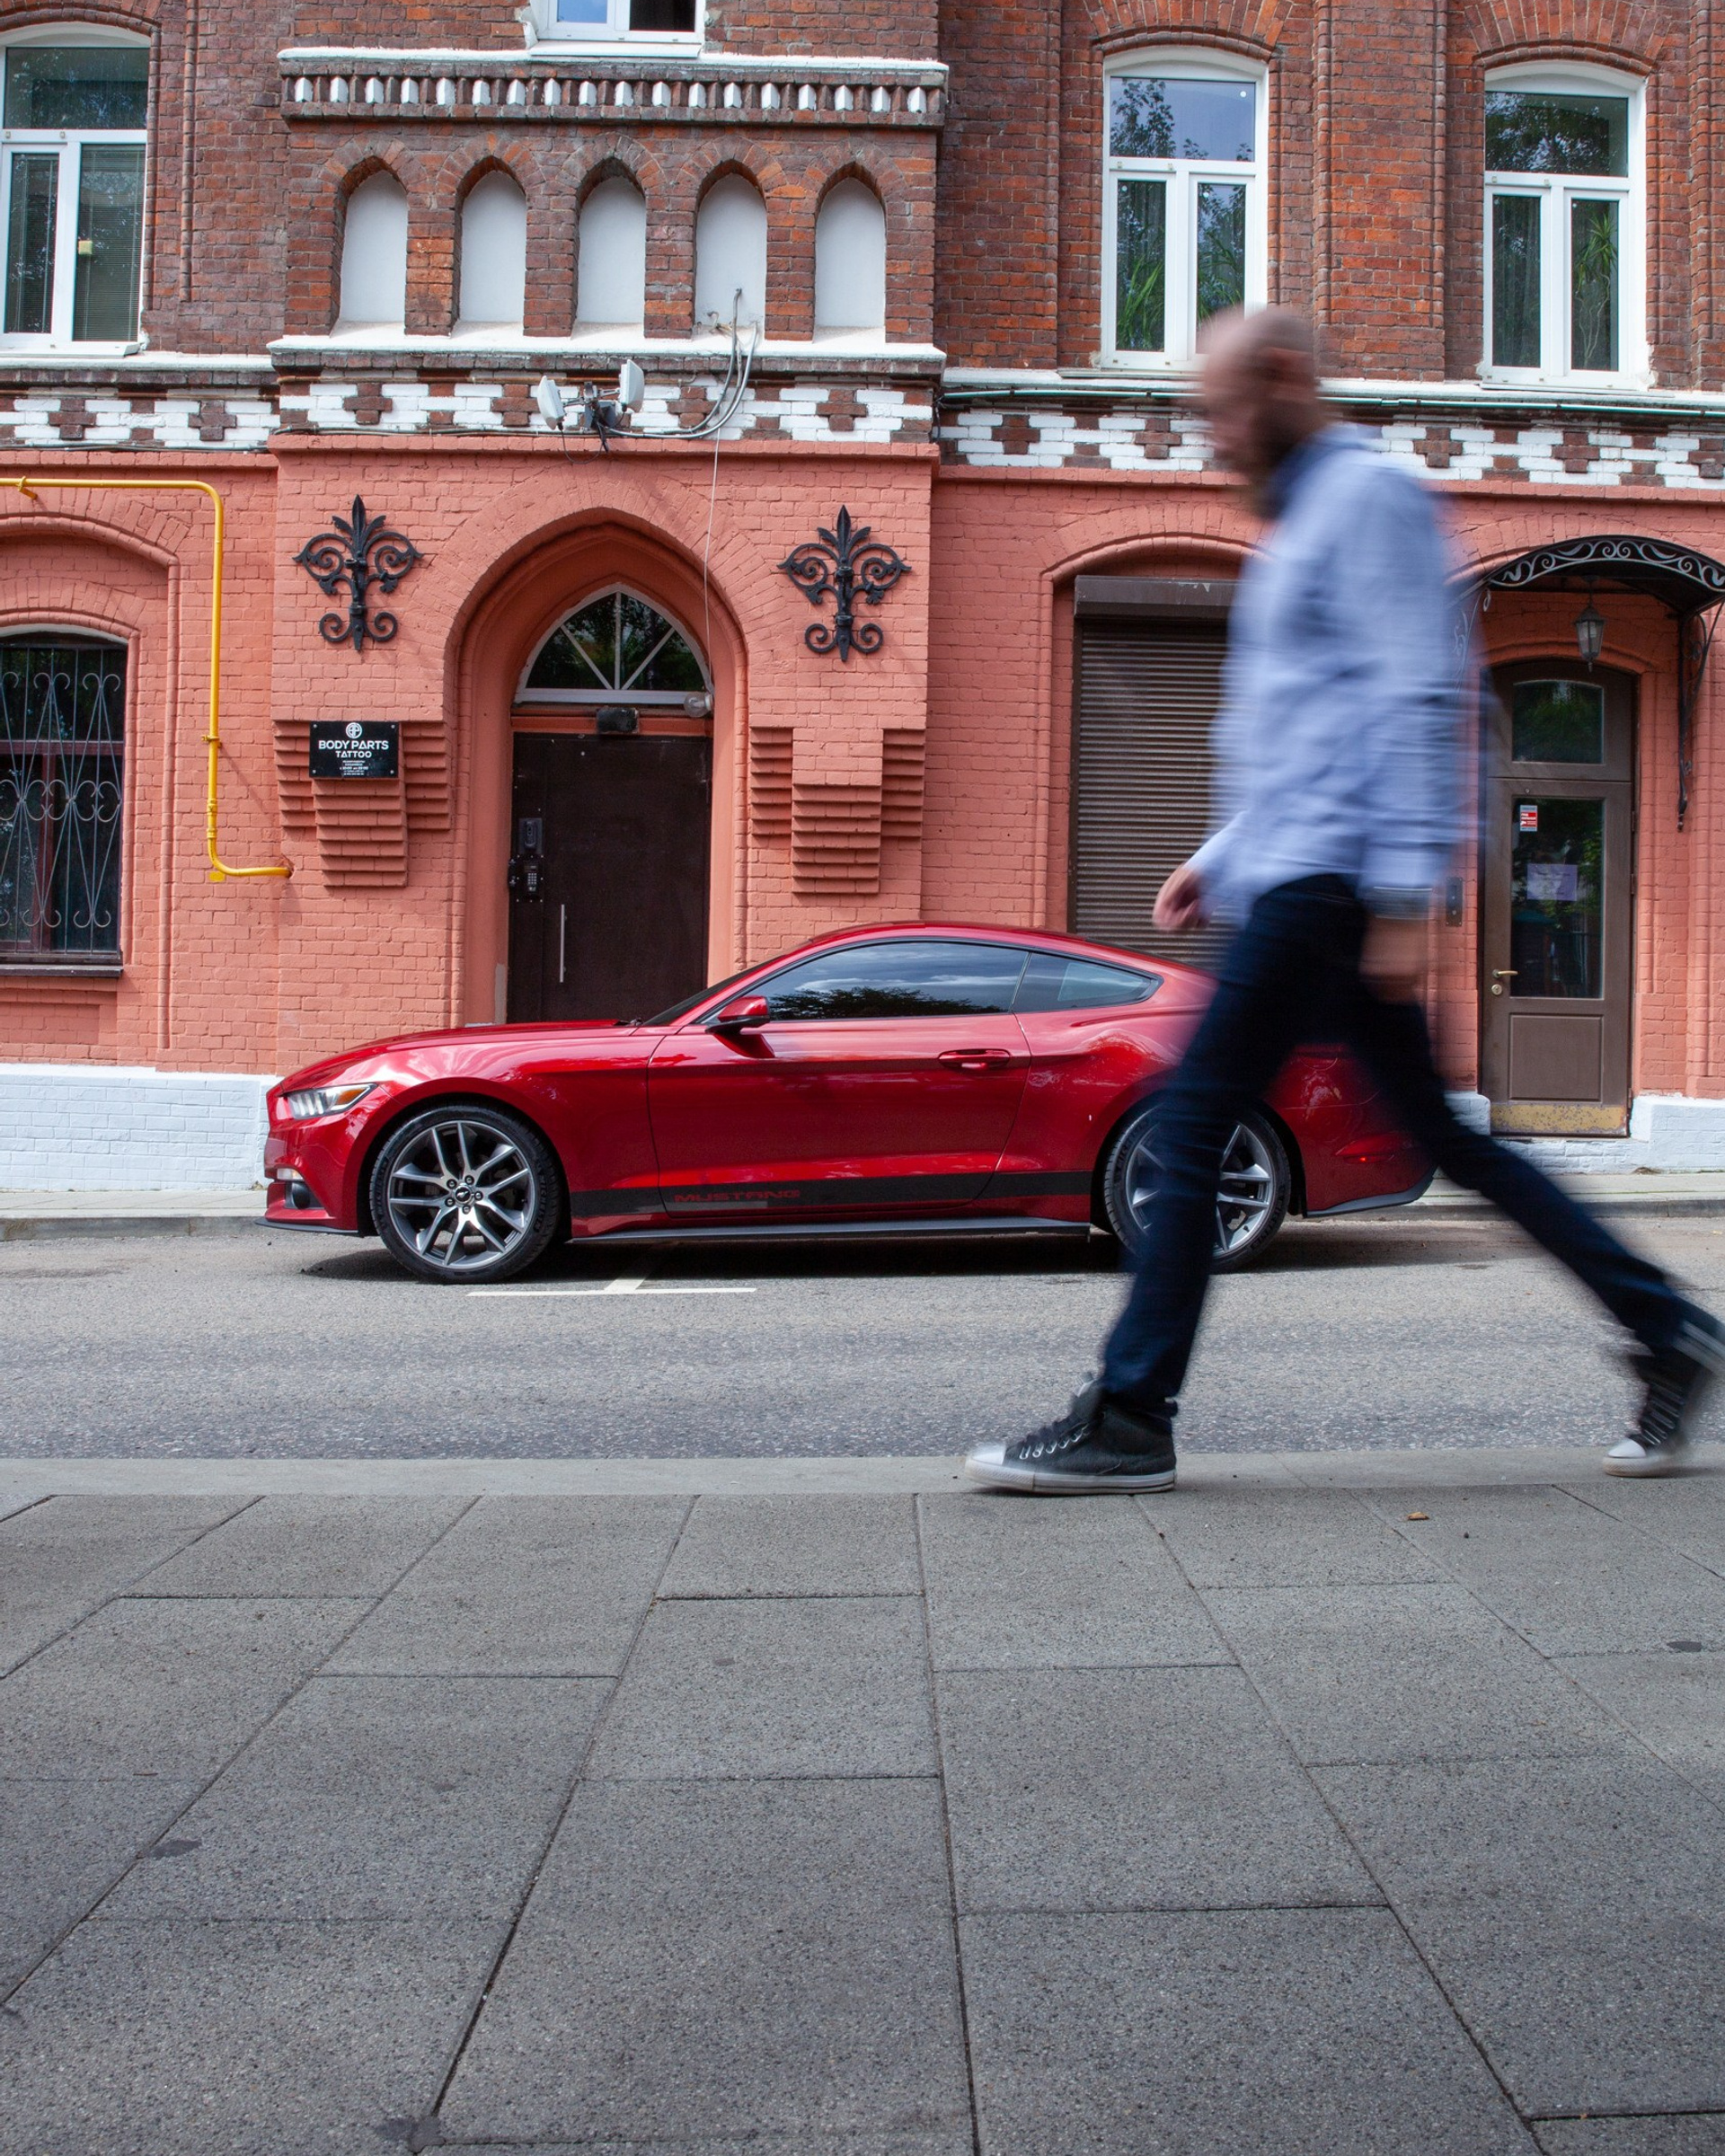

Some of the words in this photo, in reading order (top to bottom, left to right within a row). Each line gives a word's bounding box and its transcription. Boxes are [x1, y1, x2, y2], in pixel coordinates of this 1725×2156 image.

[318, 740, 350, 750] BODY
[351, 740, 389, 750] PARTS
[335, 750, 372, 758] TATTOO
[675, 1189, 801, 1202] MUSTANG
